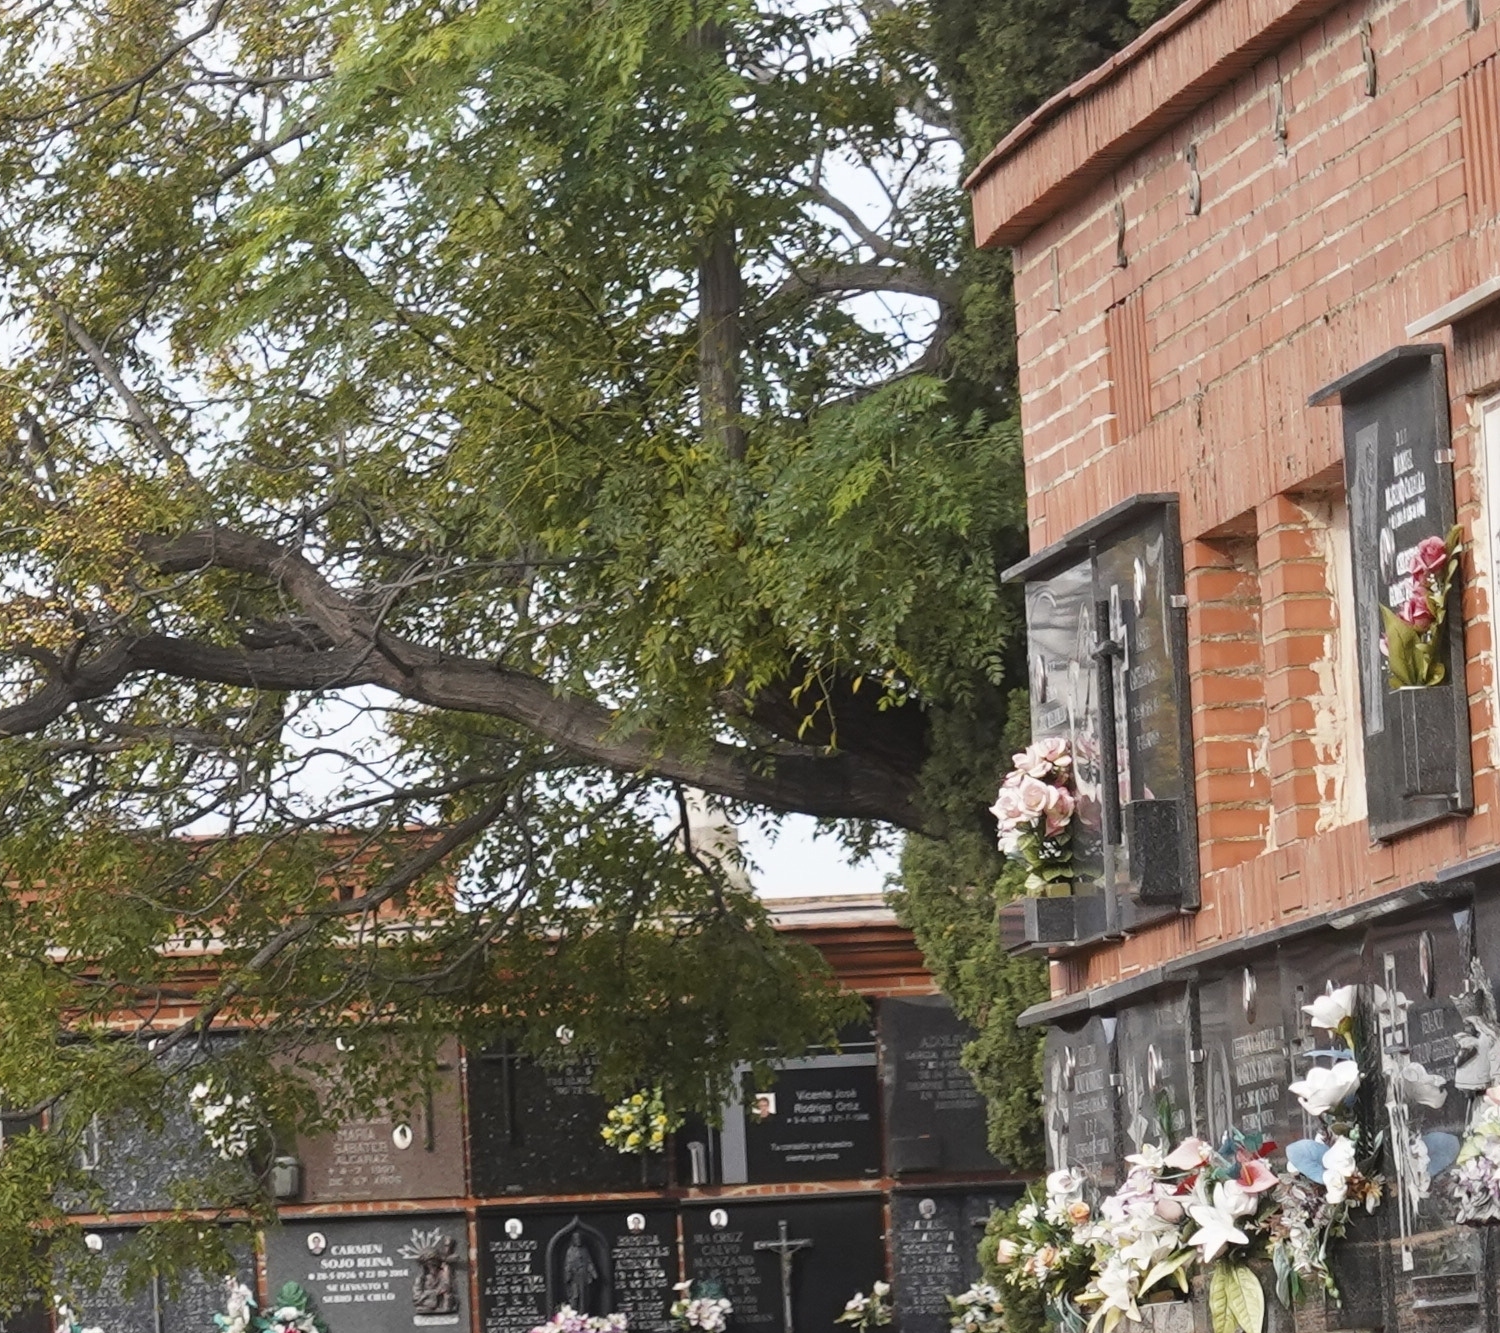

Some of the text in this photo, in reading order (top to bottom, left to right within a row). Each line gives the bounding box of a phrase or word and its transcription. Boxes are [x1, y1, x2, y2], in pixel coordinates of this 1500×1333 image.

[330, 1243, 383, 1256] CARMEN
[320, 1256, 394, 1269] SOJO REINA
